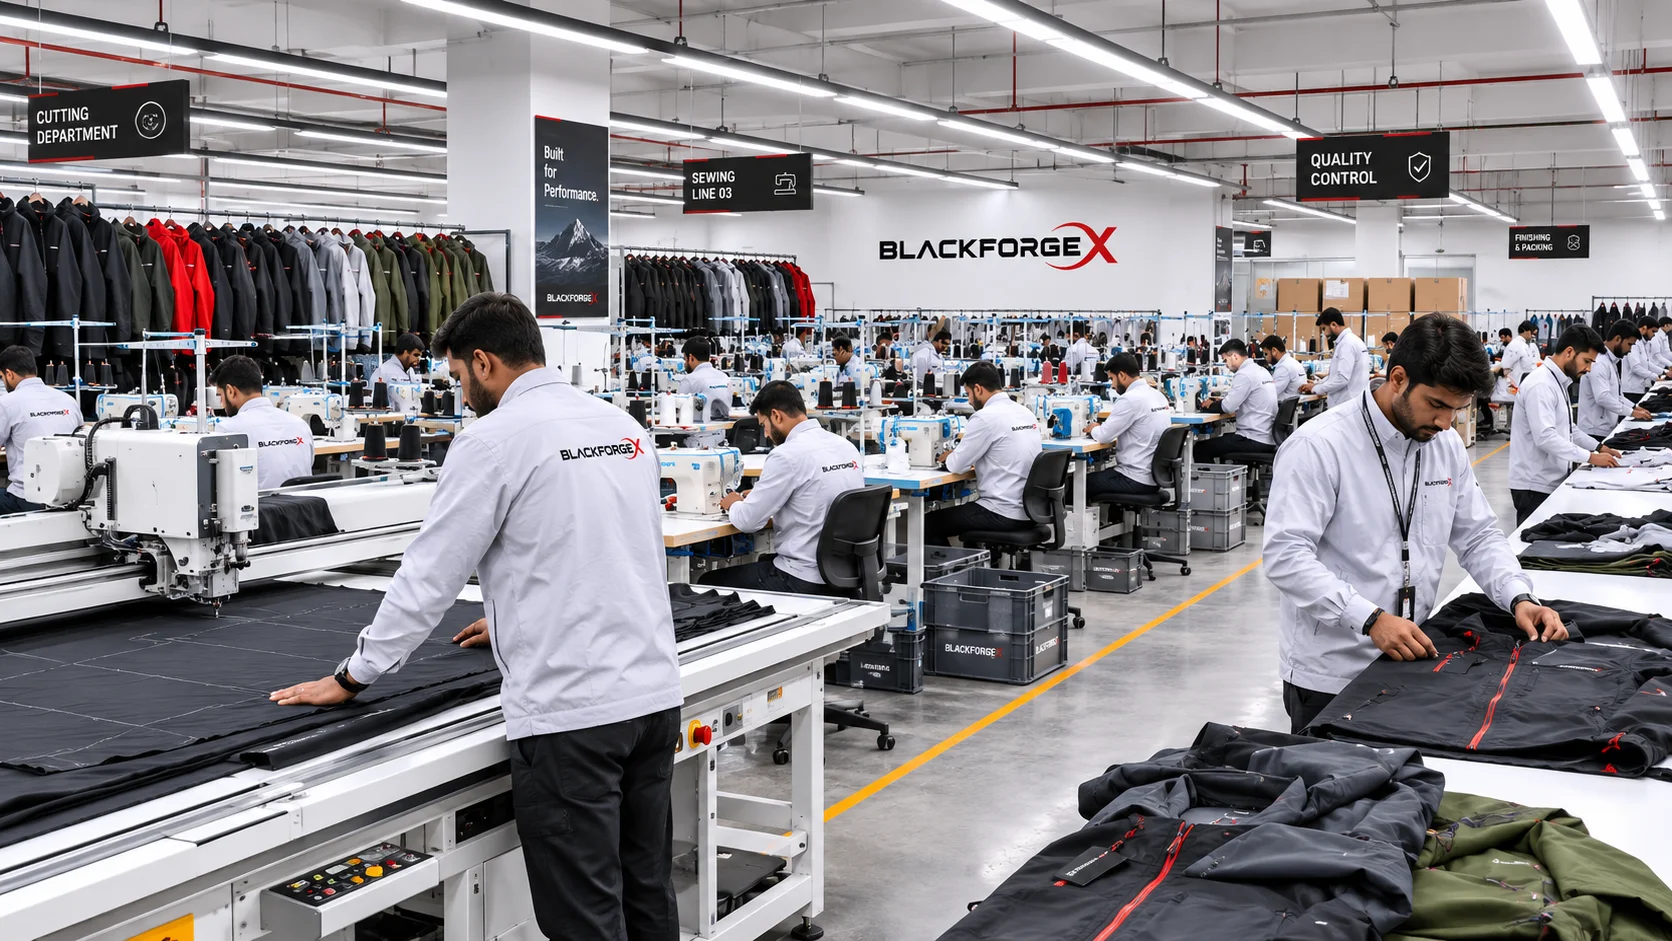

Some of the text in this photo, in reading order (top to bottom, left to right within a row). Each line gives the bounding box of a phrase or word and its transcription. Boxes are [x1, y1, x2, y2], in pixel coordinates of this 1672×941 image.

[36, 106, 89, 124] CUTTING
[36, 124, 118, 144] DEPARTMENT
[544, 145, 565, 162] Built
[1311, 151, 1373, 168] QUALITY
[544, 163, 558, 179] for
[692, 170, 736, 184] SEWING
[1311, 170, 1378, 187] CONTROL
[544, 183, 600, 202] Performance.
[692, 187, 733, 200] LINE 03
[879, 222, 1118, 270] BLACKFORGEX
[560, 437, 645, 461] BLACKFORGEX
